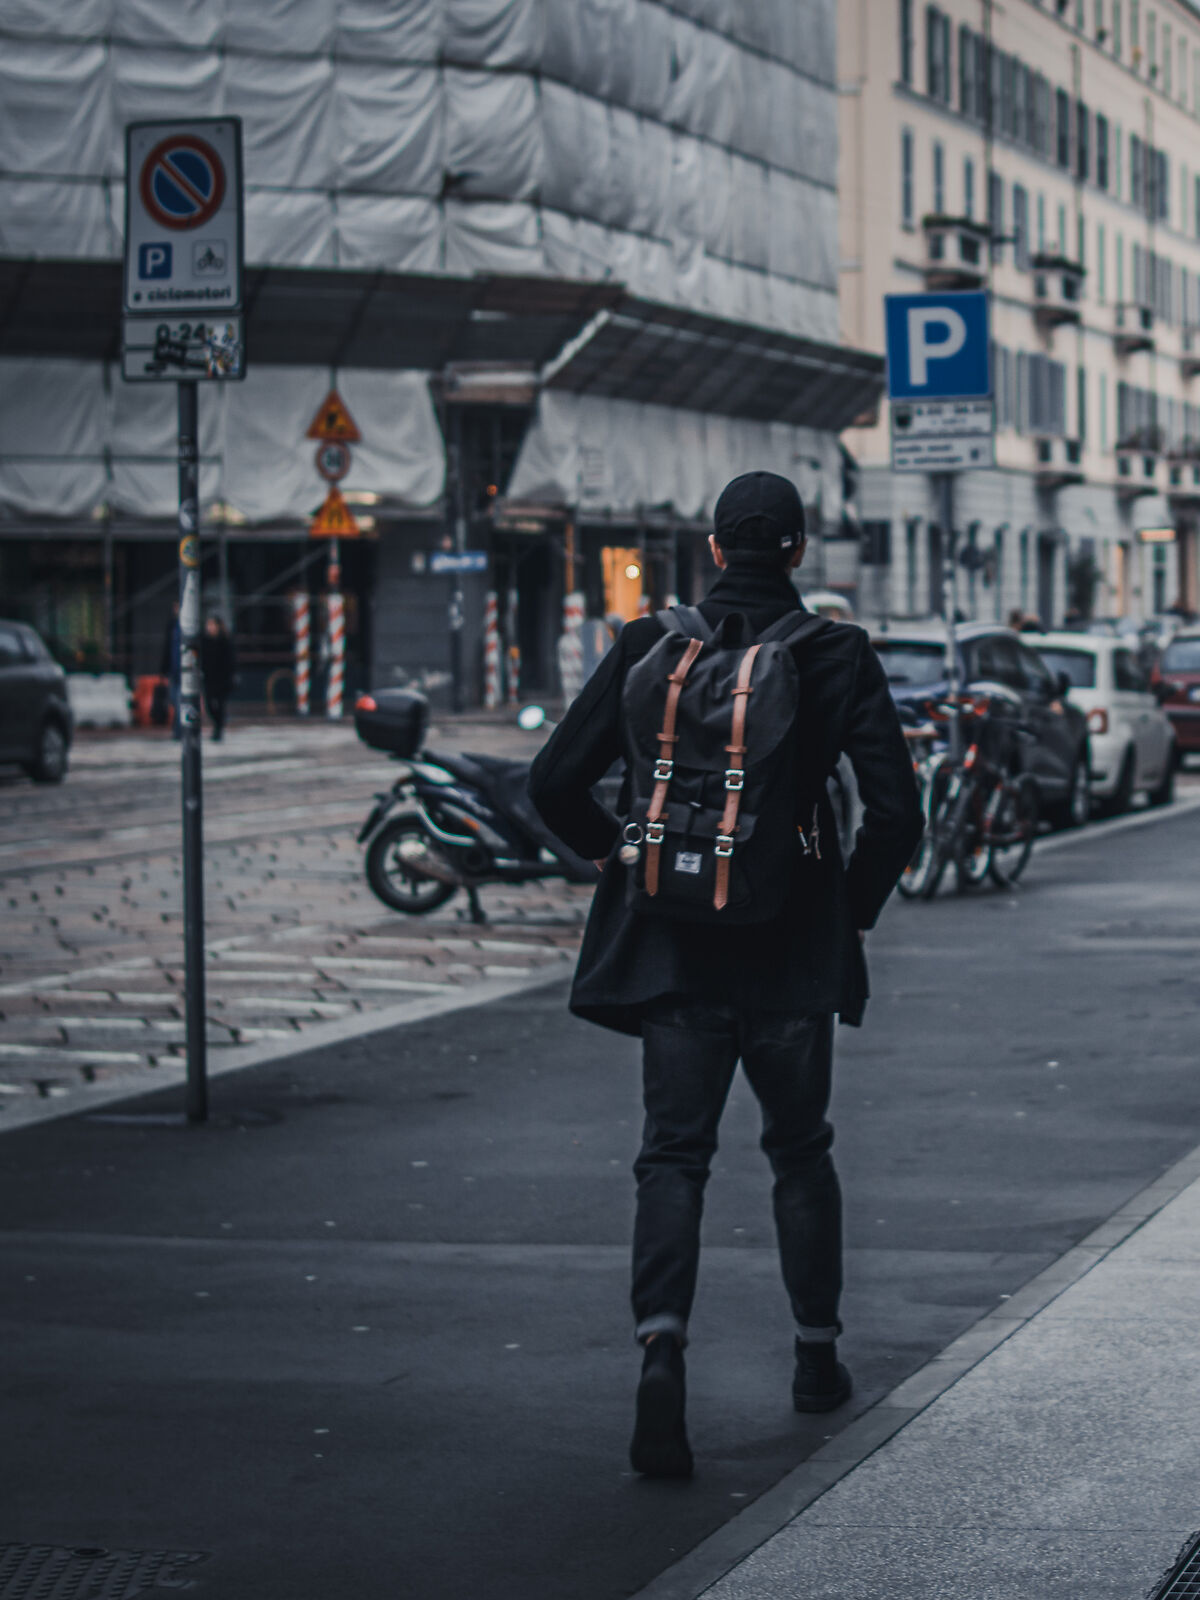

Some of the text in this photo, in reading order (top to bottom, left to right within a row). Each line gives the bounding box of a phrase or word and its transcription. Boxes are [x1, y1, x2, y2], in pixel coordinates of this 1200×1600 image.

[146, 248, 166, 275] P
[147, 286, 231, 302] ciclomotori
[156, 322, 206, 341] 0-24
[907, 306, 967, 387] P
